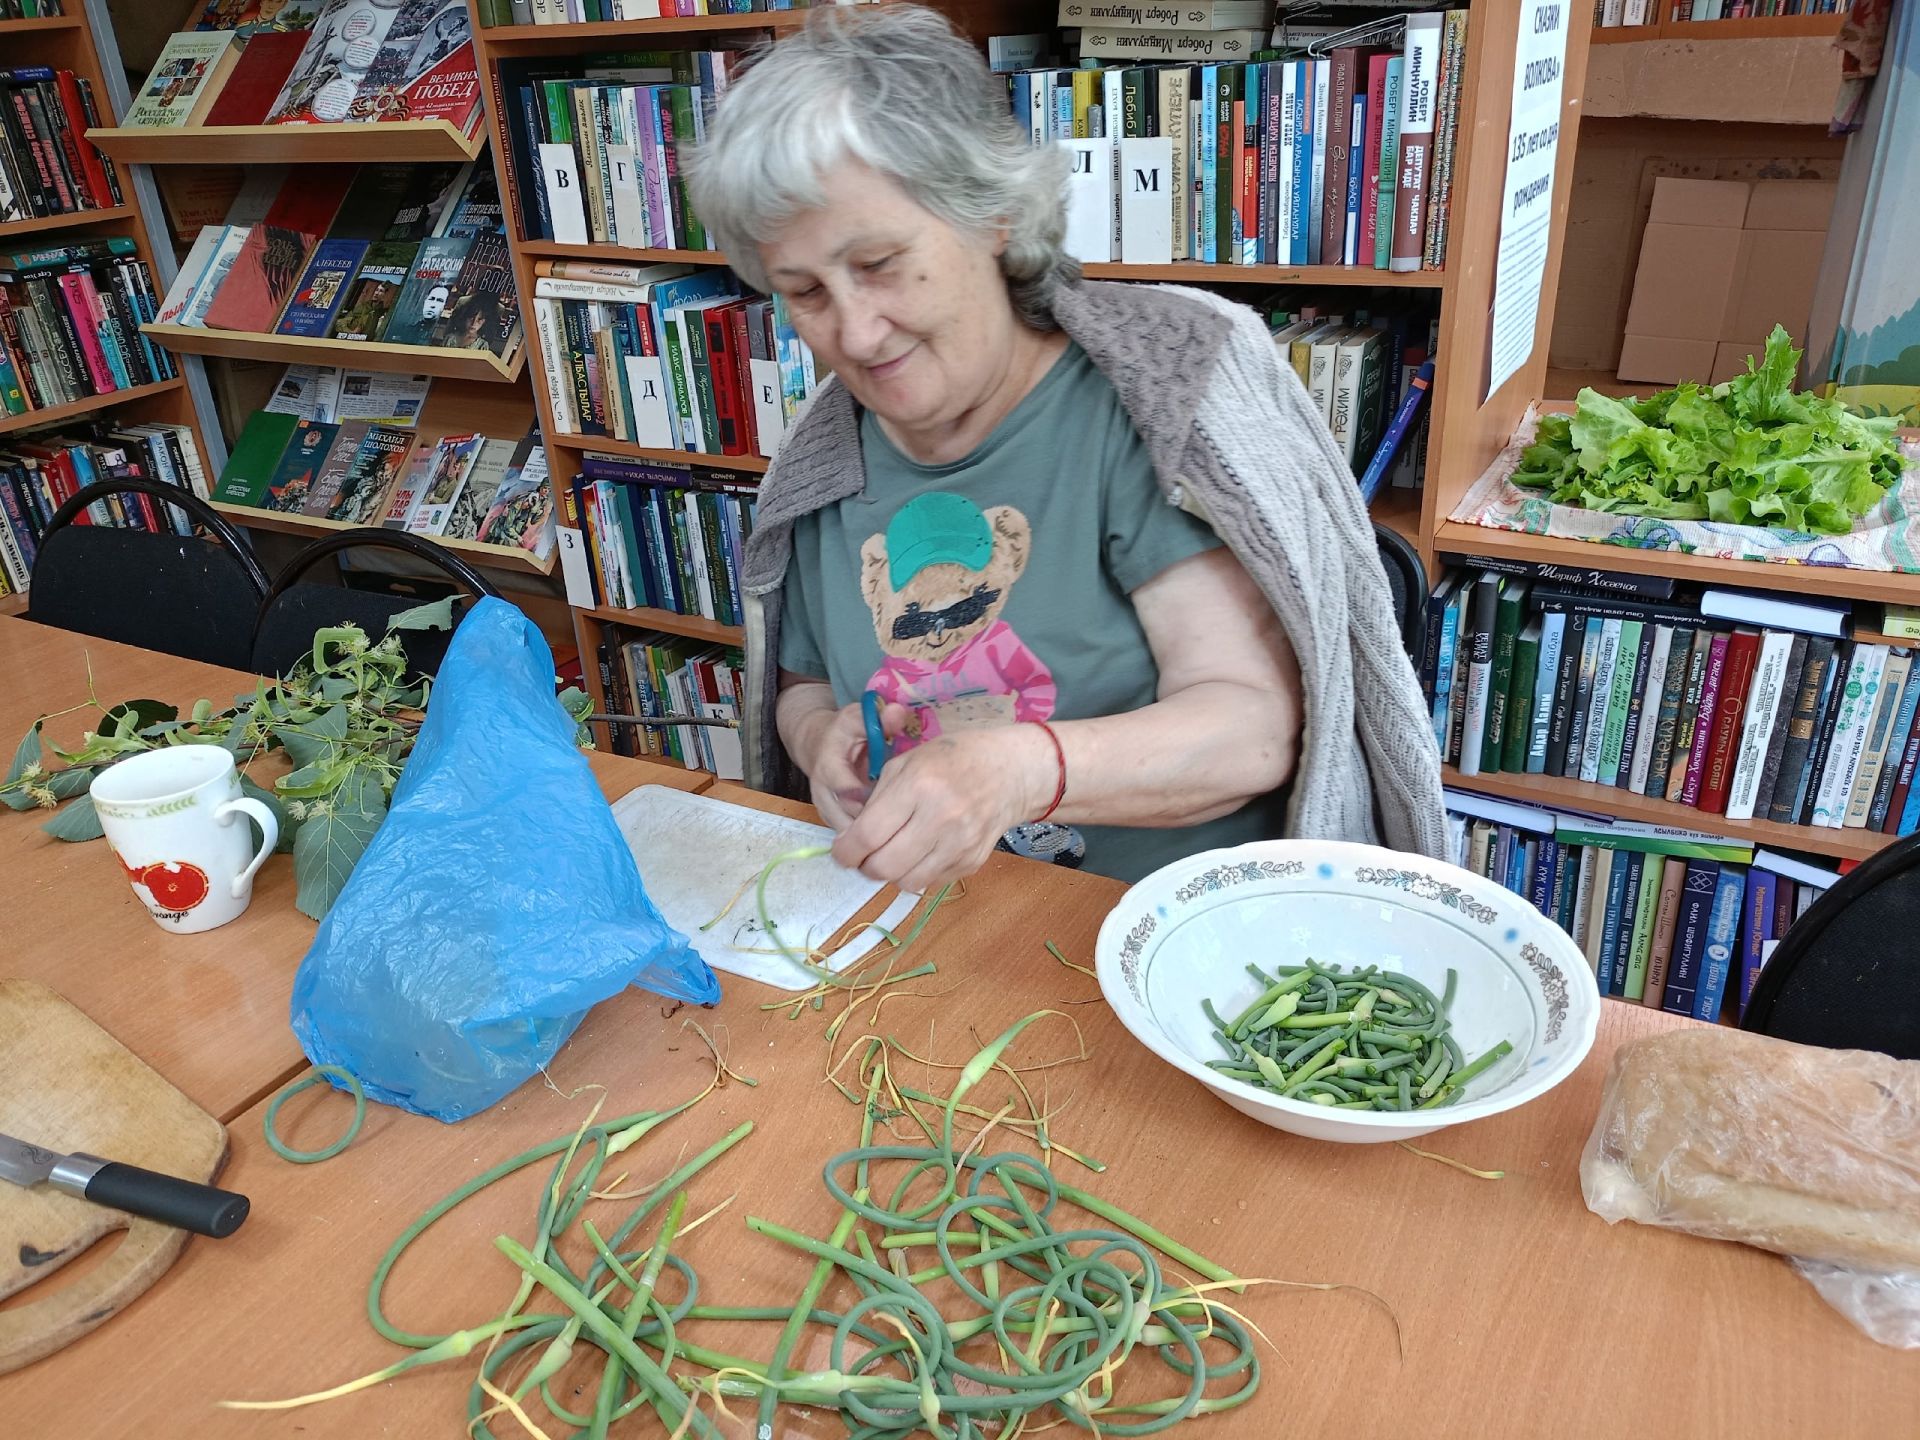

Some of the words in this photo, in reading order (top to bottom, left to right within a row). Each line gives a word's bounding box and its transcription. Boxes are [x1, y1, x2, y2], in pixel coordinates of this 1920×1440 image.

[1090, 7, 1142, 25] Миңнуллин
[1146, 9, 1179, 25] Роберт
[1534, 4, 1560, 34] СКАЗКИ
[1116, 37, 1174, 54] Миңнуллин
[1177, 39, 1213, 55] Роберт
[413, 81, 477, 100] ПОБЕД
[428, 70, 479, 85] ВЕЛИКИХ
[1336, 63, 1346, 94] РАФАЭЛЬ
[1407, 46, 1423, 123] МИҢНУЛЛИН
[1124, 85, 1137, 129] Ләбиб
[1388, 75, 1399, 116] РОБЕРТ
[1417, 80, 1430, 123] РОБЕРТ
[1269, 94, 1280, 141] КАЙТАВАЗЫ
[1296, 99, 1304, 141] ГАСЫРЛАР
[1333, 94, 1344, 134] МОСТАФИН
[1382, 118, 1396, 181] МИҢНУЛЛИН
[1405, 145, 1414, 168] БАР
[1511, 132, 1527, 163] 135
[1526, 130, 1539, 156] лет
[1539, 130, 1547, 150] со
[31, 141, 52, 188] Кристофер
[616, 161, 627, 182] Г
[1072, 150, 1093, 174] Л
[1268, 142, 1278, 182] ЯШЬЛЕГЕМ
[1294, 143, 1302, 189] АРАСЫНДА
[1411, 145, 1424, 191] ДЕПУТАТ
[555, 169, 570, 188] В
[1134, 168, 1160, 192] М
[1402, 171, 1412, 189] ИДЕ
[1512, 173, 1550, 218] рождения
[1292, 191, 1300, 240] УЙЛАНУЛАР
[1409, 195, 1421, 236] ЧАКЛАР
[315, 258, 353, 269] АЛЕКСЕЕВ
[415, 270, 443, 280] ВОИН
[419, 256, 466, 271] ТАТАРСКИЙ
[459, 264, 478, 288] НА
[479, 268, 518, 296] ВОЙН
[671, 345, 681, 372] ИЛДУС
[573, 350, 592, 422] АЛБАСТЫЛАР
[643, 380, 657, 401] Д
[674, 373, 688, 414] ДИНДАРОВ
[763, 386, 774, 404] Е
[1315, 388, 1325, 413] ИМ
[1335, 387, 1350, 436] РӘХИМ
[364, 442, 405, 454] ШОЛОХОВ
[368, 432, 405, 445] МИХАИЛ
[1547, 631, 1559, 672] Кыйбла
[1619, 647, 1627, 668] ХАН
[1535, 693, 1551, 724] Халим
[1686, 687, 1695, 704] ХАН
[1529, 724, 1545, 757] Айдар
[1624, 714, 1637, 750] МИЛӘШ
[1619, 751, 1631, 774] ЕЛЫ
[1709, 756, 1721, 790] КОЯШ!
[150, 909, 189, 923] range
[1689, 902, 1700, 923] ФАИЛ
[1679, 926, 1696, 979] ШӘФИГУЛЛИН
